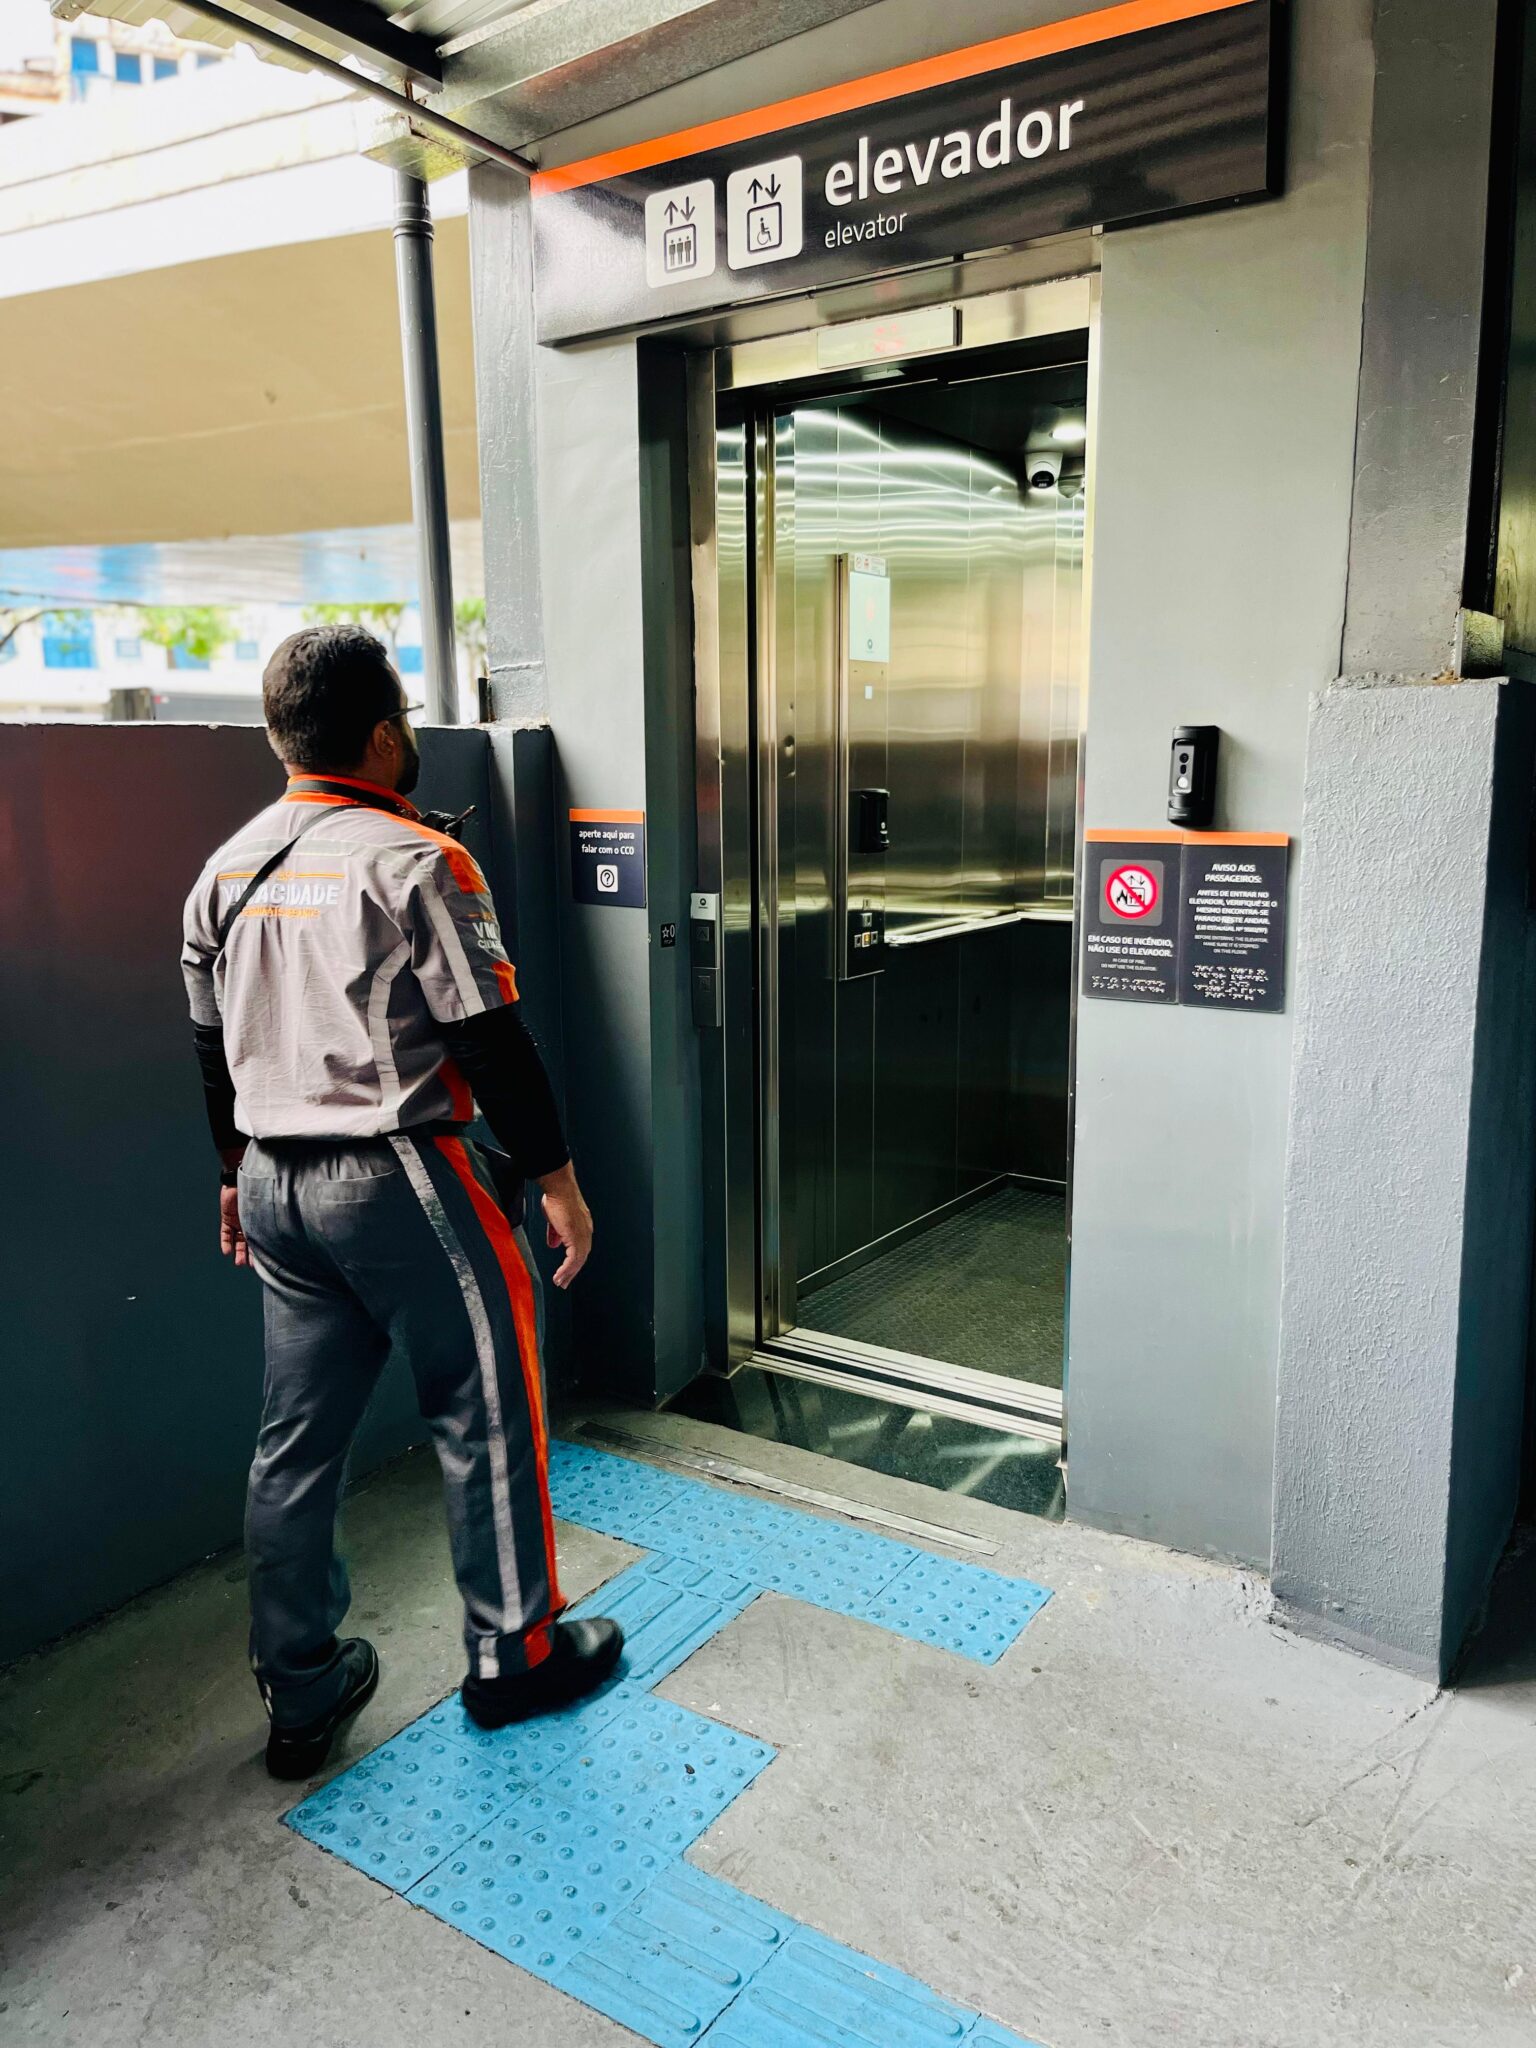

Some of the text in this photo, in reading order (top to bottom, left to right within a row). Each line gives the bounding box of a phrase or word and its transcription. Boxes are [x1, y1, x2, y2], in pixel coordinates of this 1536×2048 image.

[824, 98, 1085, 207] elevador
[824, 209, 908, 249] elevator
[579, 830, 635, 841] aperte aqui para
[582, 844, 598, 853] falar
[1212, 864, 1237, 872] AVISO
[1205, 874, 1262, 883] PASSAGEIROS:
[1189, 898, 1225, 906] ELEVADOR,
[1134, 937, 1174, 948] INCÊNDIO,
[1088, 944, 1104, 953] NÃO
[1106, 946, 1120, 954] USE
[1129, 948, 1173, 957] ELEVADOR.
